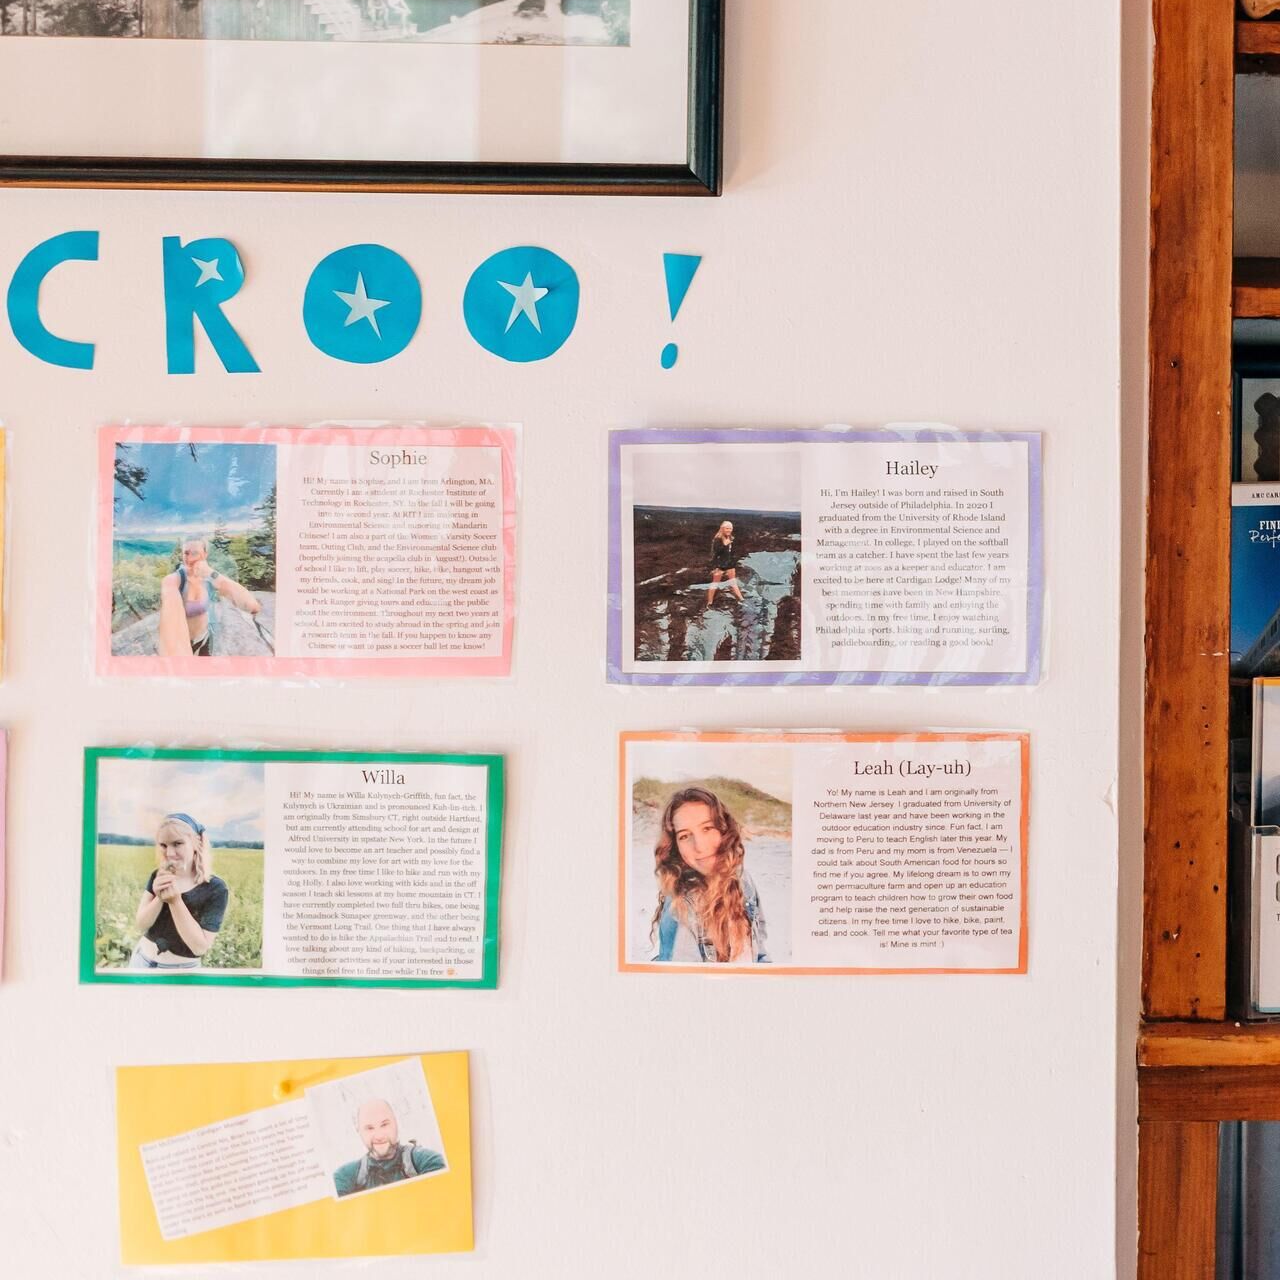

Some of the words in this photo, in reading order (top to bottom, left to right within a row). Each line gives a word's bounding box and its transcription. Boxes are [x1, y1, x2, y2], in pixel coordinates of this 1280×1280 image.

[369, 449, 428, 469] Sophie
[886, 459, 939, 479] Hailey
[361, 769, 406, 785] Willa
[854, 759, 894, 776] Leah
[899, 759, 972, 779] (Lay-uh)
